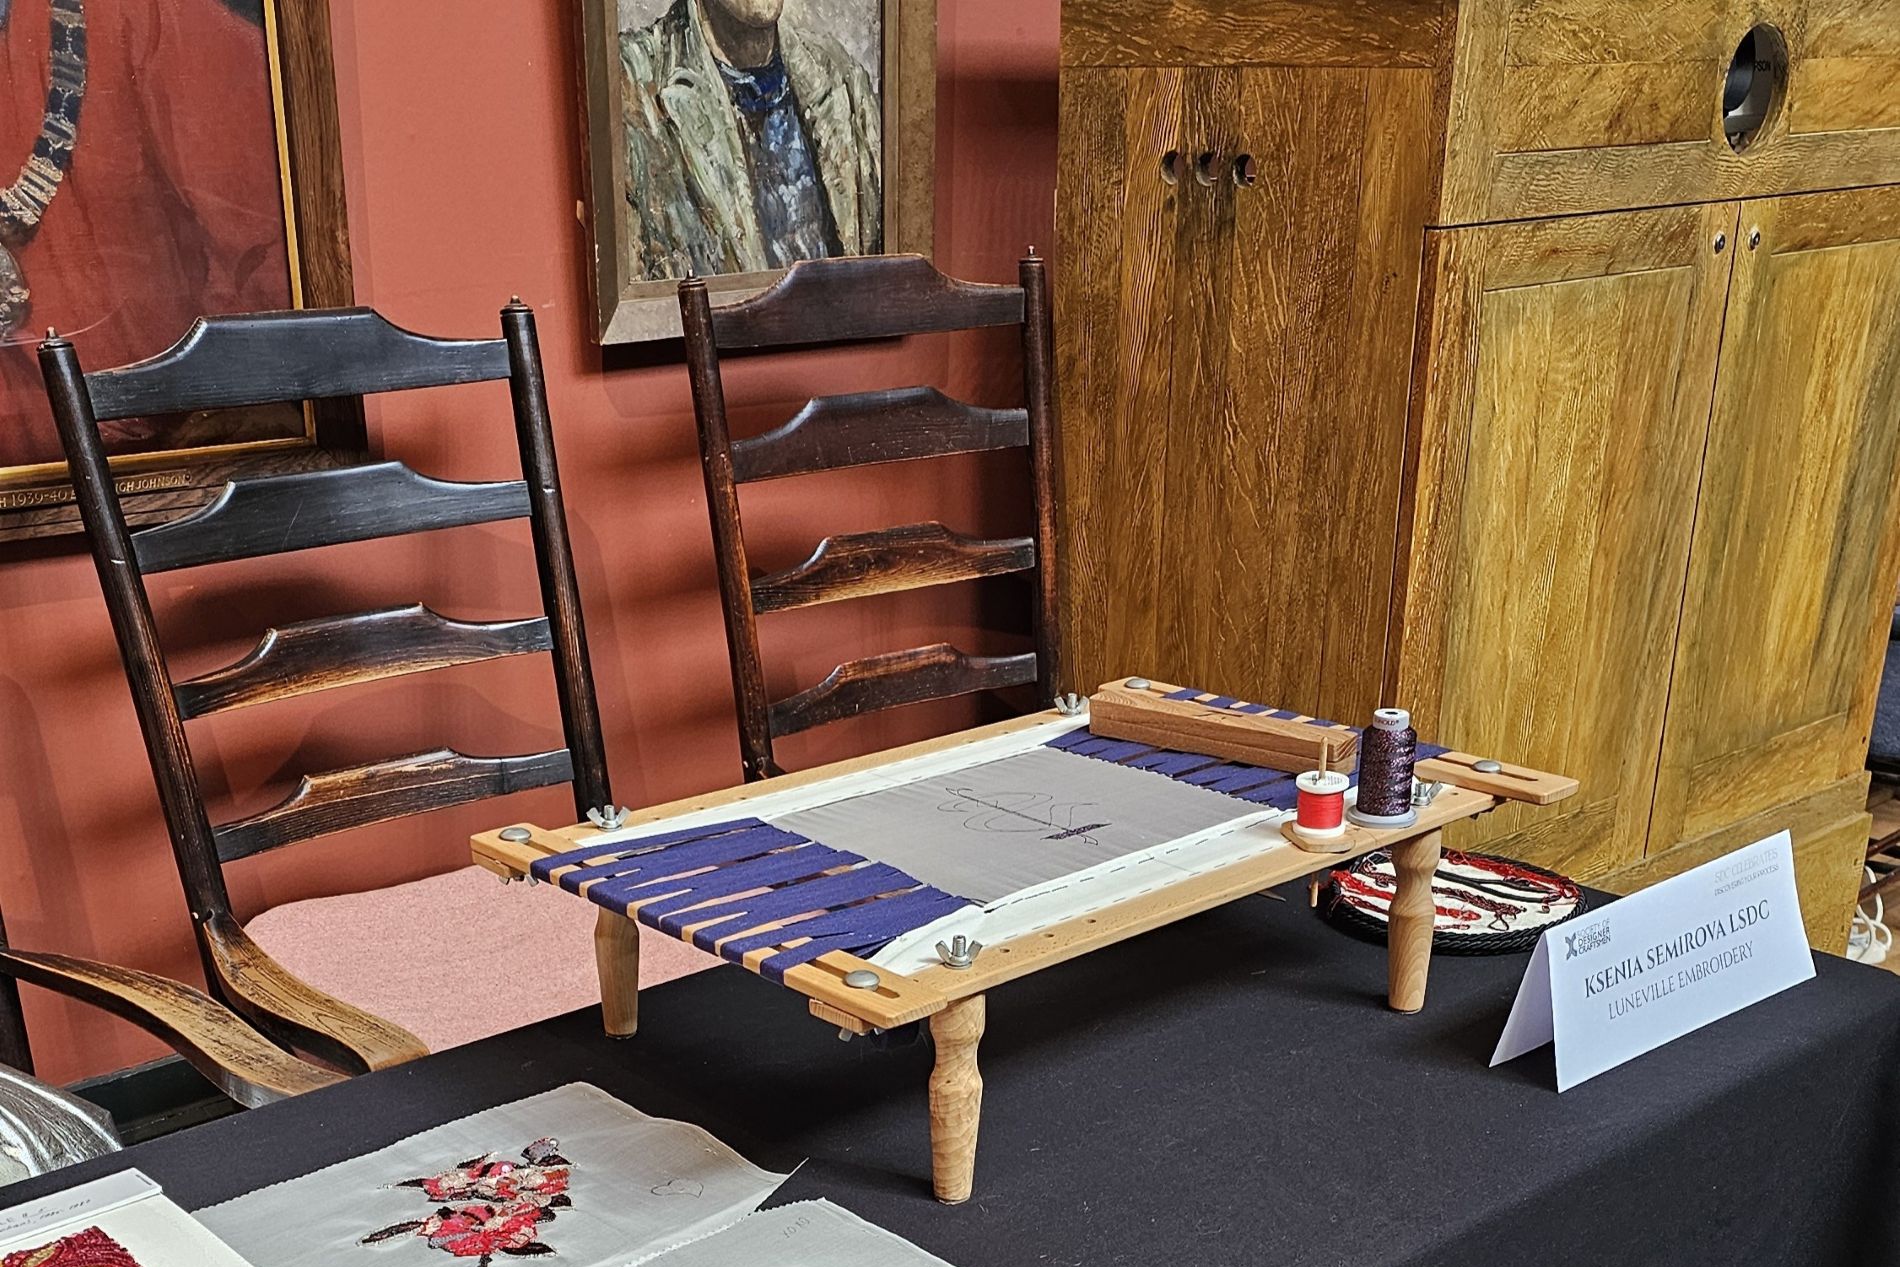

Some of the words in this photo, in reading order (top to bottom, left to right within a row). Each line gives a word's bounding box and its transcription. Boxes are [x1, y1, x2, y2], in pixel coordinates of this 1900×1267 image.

[135, 474, 186, 490] JOHNSON
[1578, 926, 1610, 947] DESIGNER
[1578, 934, 1611, 955] CRAFTSMEN
[1585, 955, 1644, 999] KSENIA
[1646, 918, 1727, 971] SEMIROVA
[1728, 899, 1771, 934] LSDC
[1608, 974, 1676, 1021] LUNEVILLE
[1678, 940, 1754, 990] EMBROIDERY
